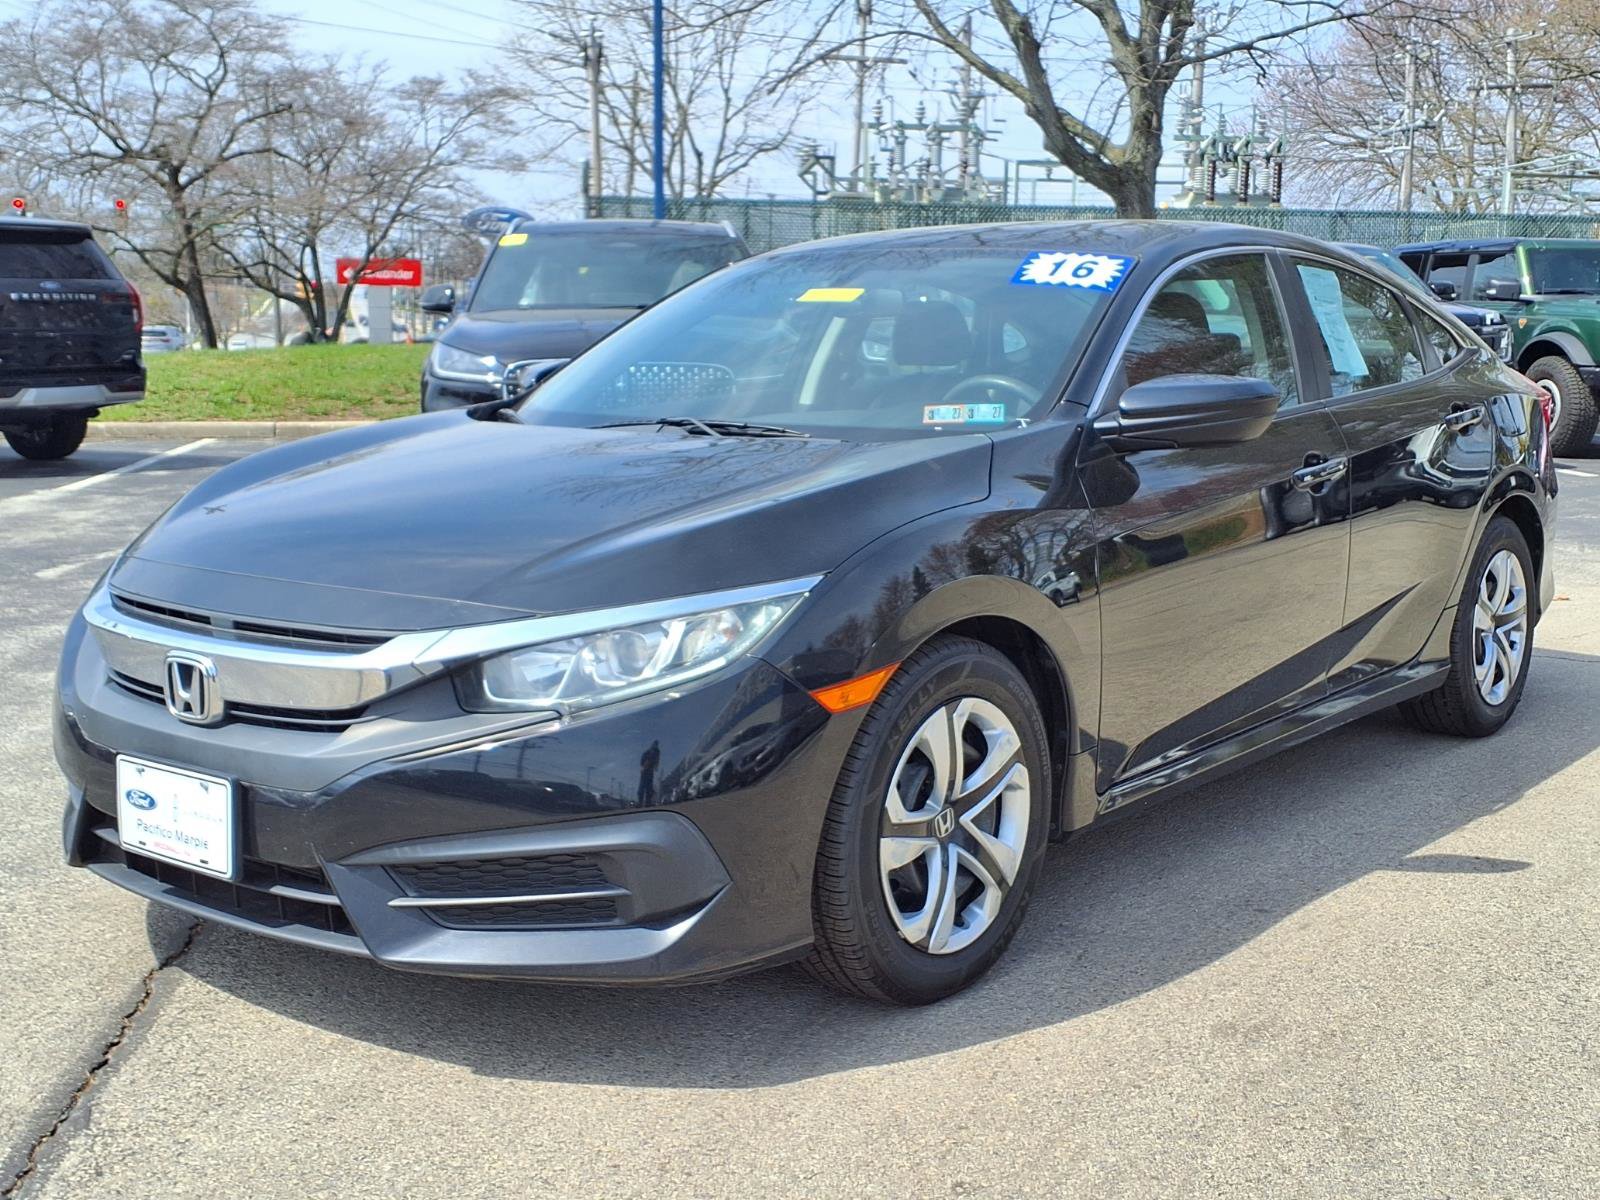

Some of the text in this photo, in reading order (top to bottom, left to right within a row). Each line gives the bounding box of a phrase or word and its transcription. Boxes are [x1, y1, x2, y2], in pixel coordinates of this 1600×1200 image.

[1048, 258, 1100, 279] 16
[951, 407, 962, 420] 27
[992, 406, 1002, 419] 27
[136, 818, 172, 839] Pacifico
[175, 829, 209, 850] Marple
